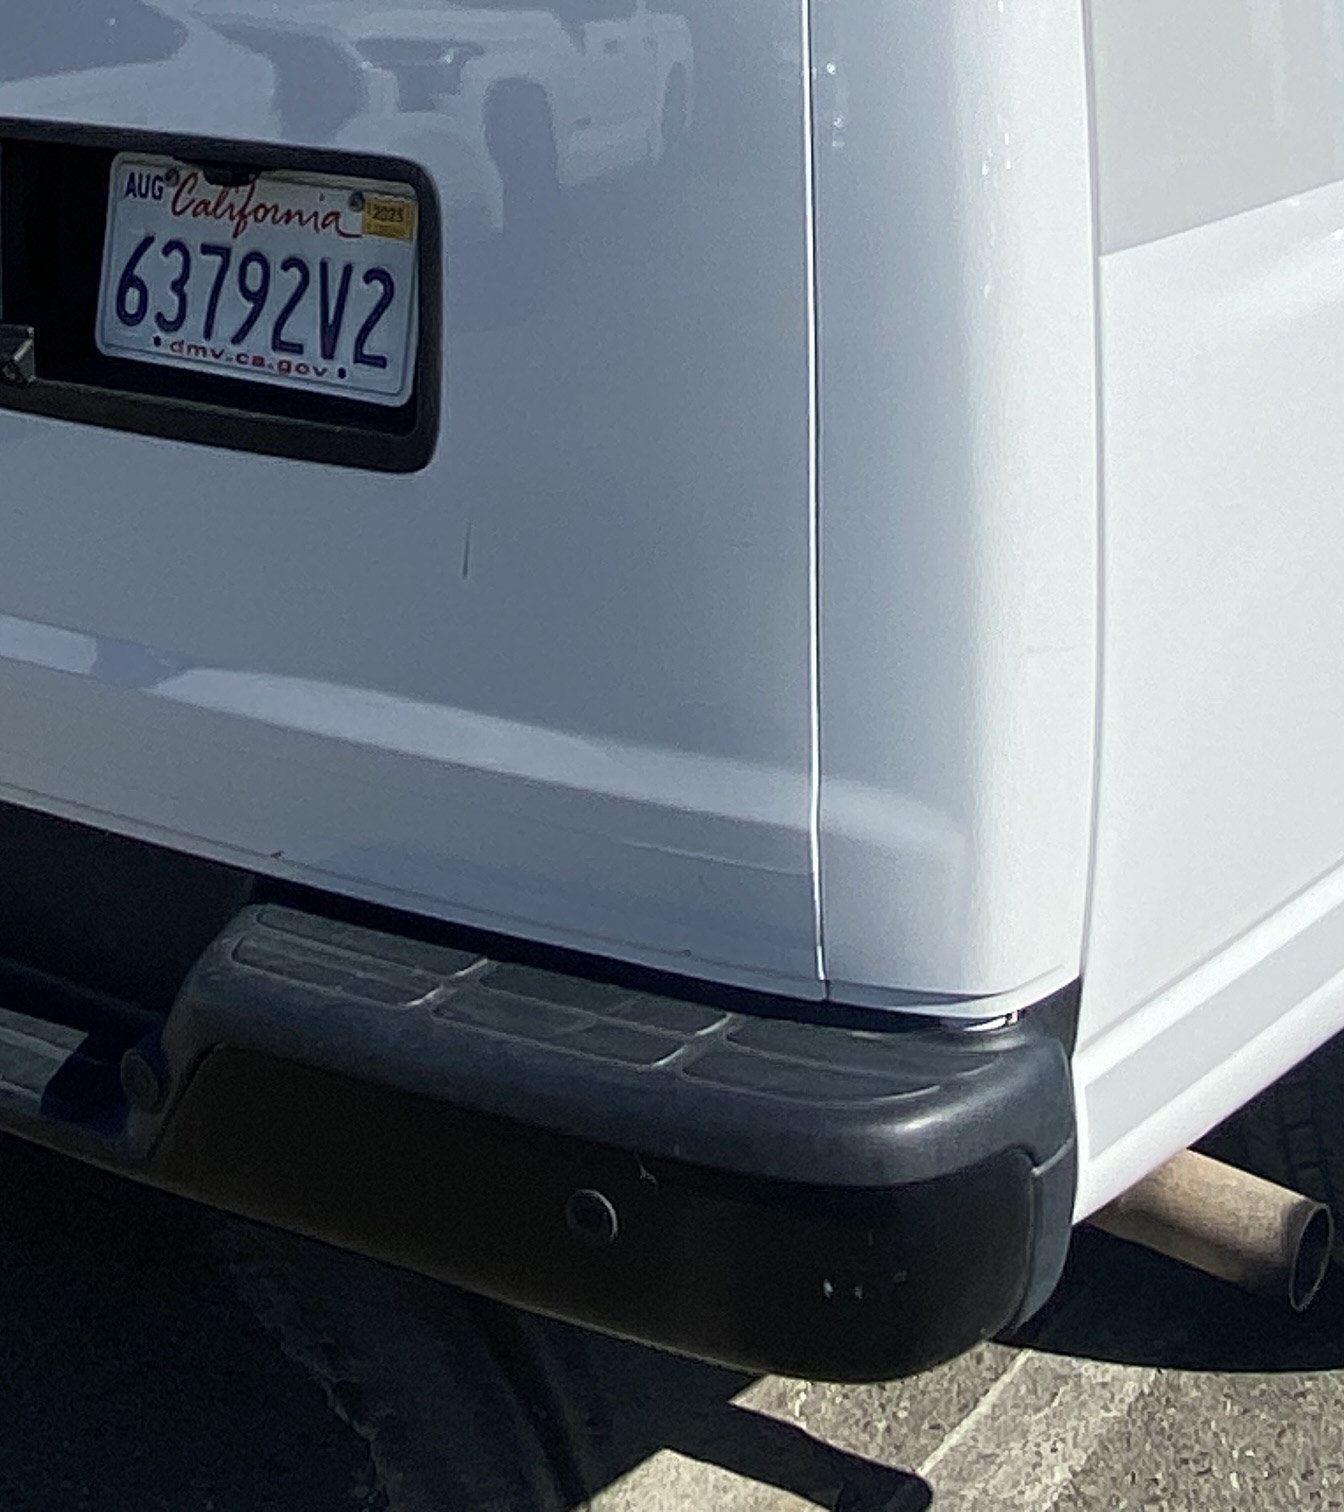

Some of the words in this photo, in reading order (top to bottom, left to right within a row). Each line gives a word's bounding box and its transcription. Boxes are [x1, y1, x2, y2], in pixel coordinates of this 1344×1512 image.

[125, 172, 163, 200] AUG
[171, 172, 362, 238] California
[116, 235, 395, 369] 63792V2
[169, 339, 328, 377] dmv.ca.gov
